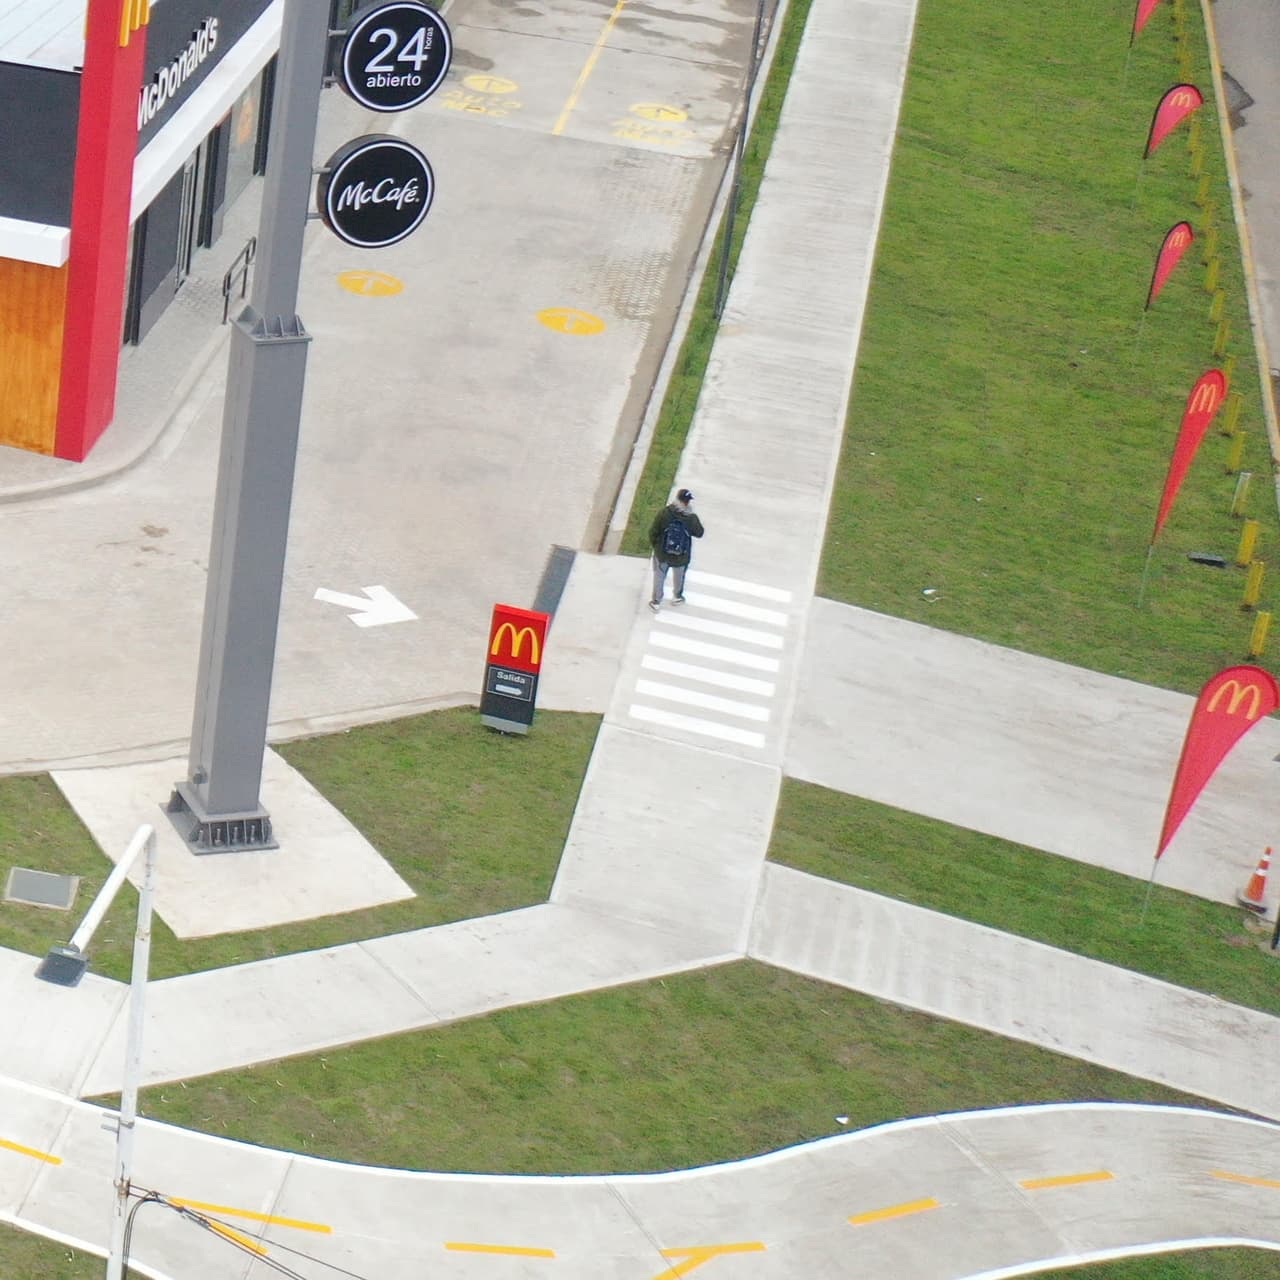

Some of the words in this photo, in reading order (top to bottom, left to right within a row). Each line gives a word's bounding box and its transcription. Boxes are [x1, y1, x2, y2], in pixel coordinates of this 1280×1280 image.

[364, 27, 428, 72] 24
[424, 26, 434, 50] horas
[366, 72, 422, 88] abierto
[337, 177, 421, 211] McCafé
[497, 671, 526, 684] Salida
